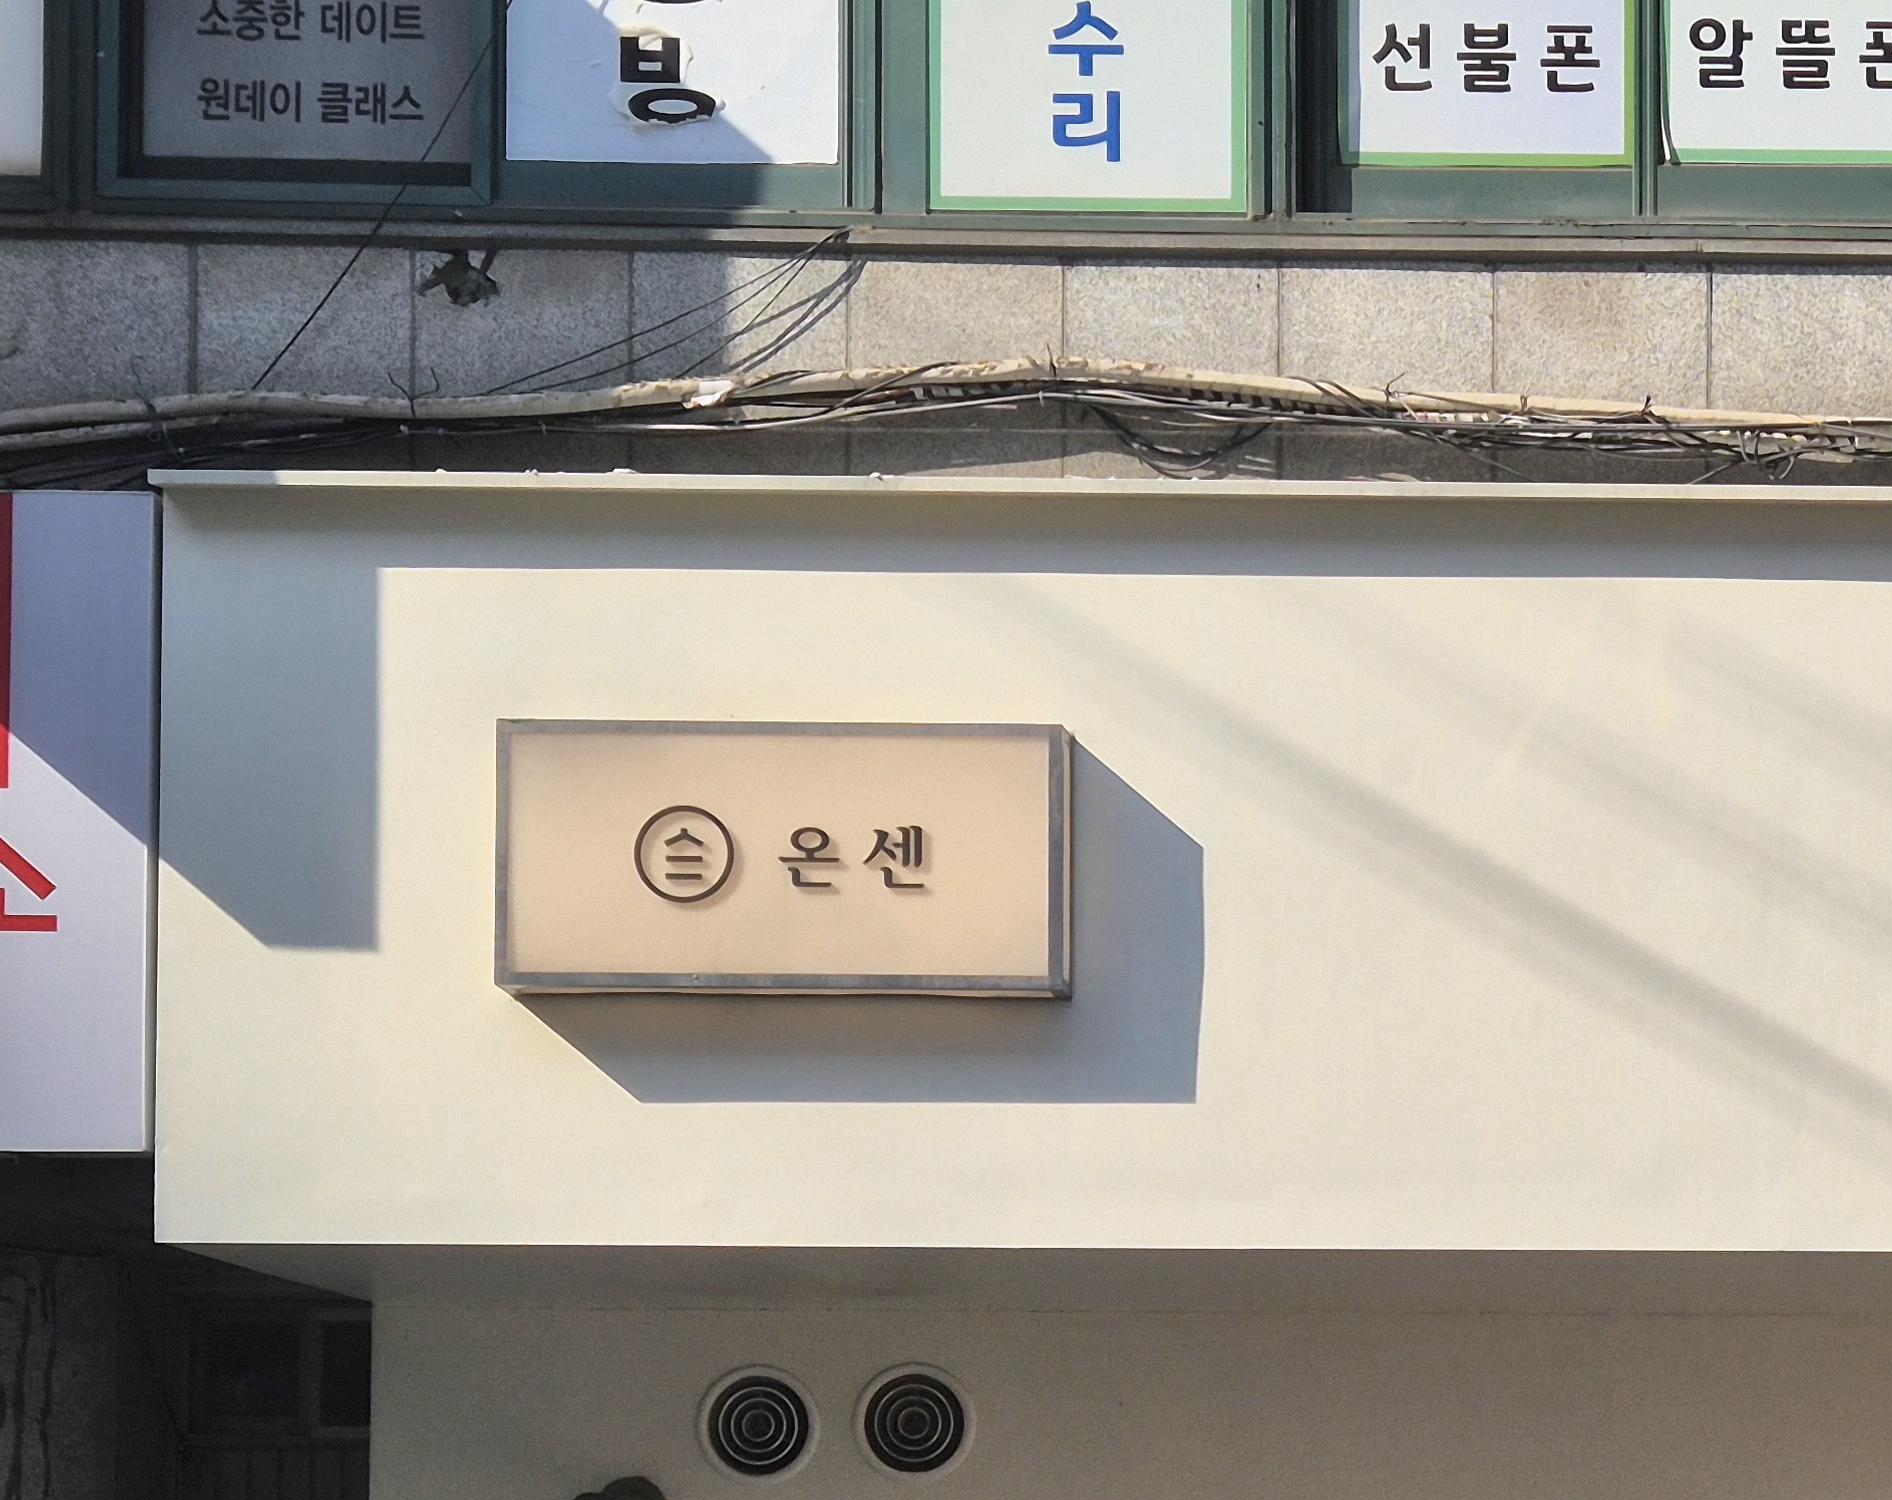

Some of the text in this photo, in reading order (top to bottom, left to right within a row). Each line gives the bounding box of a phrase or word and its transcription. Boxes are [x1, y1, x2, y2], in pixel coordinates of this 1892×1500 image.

[197, 0, 425, 43] 소중한 데이트
[1048, 1, 1125, 162] 수리
[1372, 22, 1601, 92] 선불폰
[197, 78, 425, 124] 원데이 클래스
[778, 825, 926, 889] 온센
